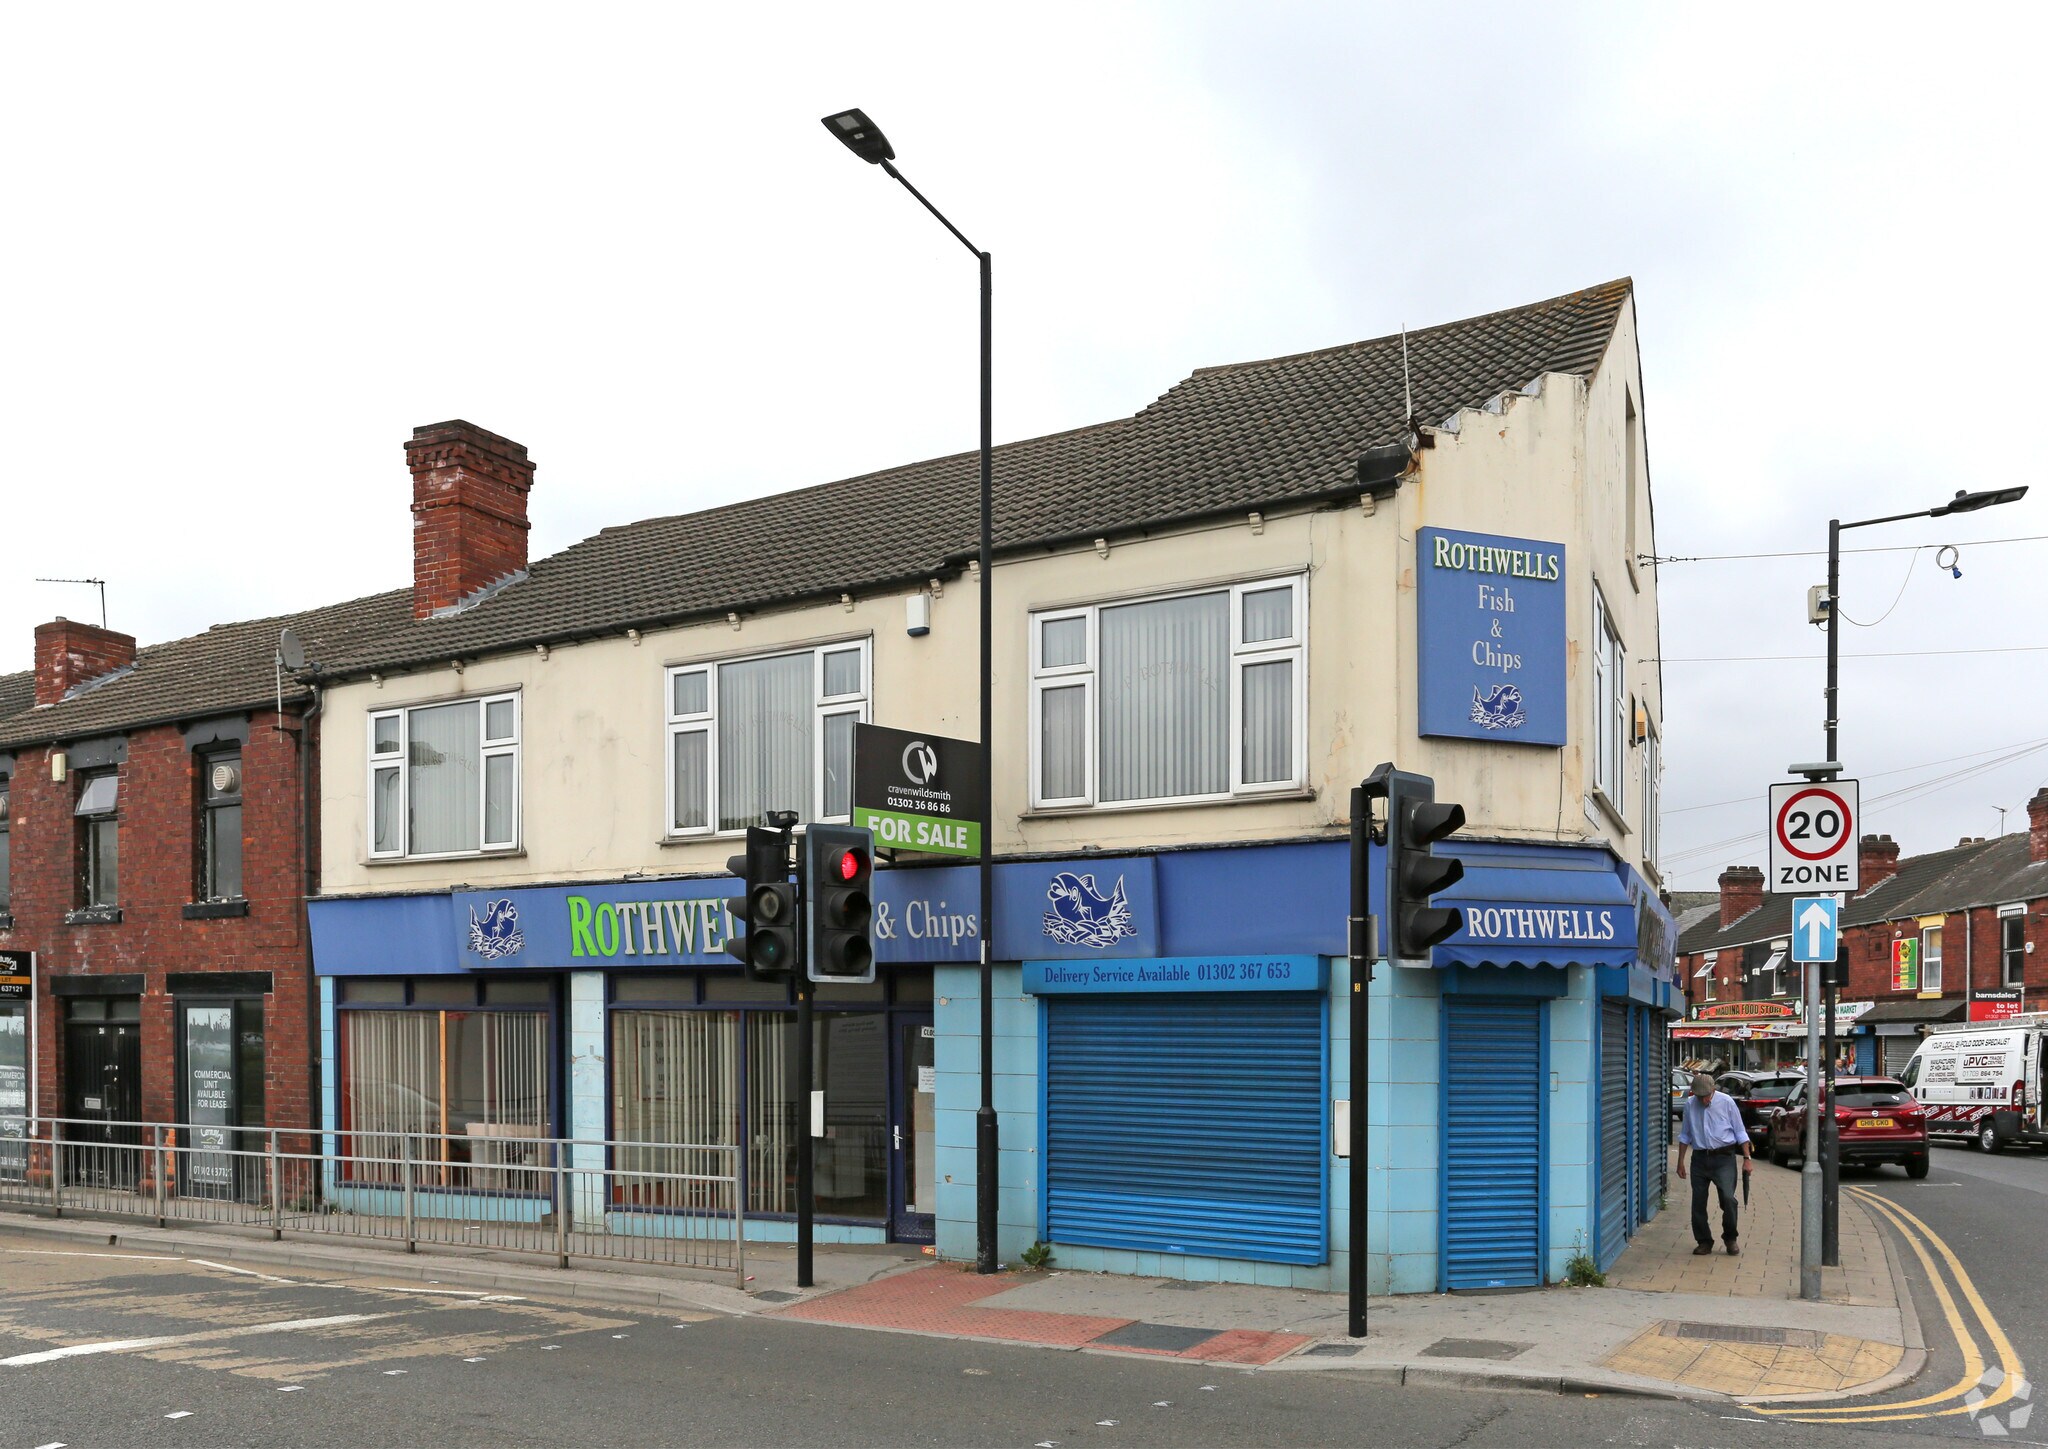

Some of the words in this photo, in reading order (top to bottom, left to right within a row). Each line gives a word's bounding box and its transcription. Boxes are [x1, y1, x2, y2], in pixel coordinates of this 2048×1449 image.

[1434, 536, 1559, 581] ROTHWELLS
[1478, 584, 1515, 613] Fish
[1490, 618, 1503, 638] &
[1472, 640, 1522, 673] Chips
[887, 785, 951, 801] cravenwildsmith
[887, 796, 913, 808] 01302
[915, 800, 926, 810] 36
[927, 802, 938, 811] 86
[940, 803, 951, 813] 86
[868, 816, 911, 843] FOR
[917, 822, 967, 849] SALE
[1788, 809, 1840, 839] 20
[1781, 864, 1849, 884] ZONE
[875, 901, 898, 940] &
[905, 900, 978, 950] Chips
[1467, 907, 1615, 940] ROTHWELLS
[1045, 965, 1090, 984] Delivery
[1093, 965, 1135, 982] Service
[1139, 965, 1190, 983] Available
[1198, 964, 1235, 980] 01302
[1240, 963, 1263, 980] 367
[1267, 962, 1291, 979] 653
[1741, 1003, 1759, 1015] FOOD
[1963, 1056, 1988, 1066] uPVC
[194, 1070, 231, 1079] COMMERCIAL
[203, 1080, 218, 1089] UNIT
[197, 1090, 225, 1099] AVAILABLE
[198, 1099, 208, 1108] FOR
[210, 1100, 227, 1109] LEASE
